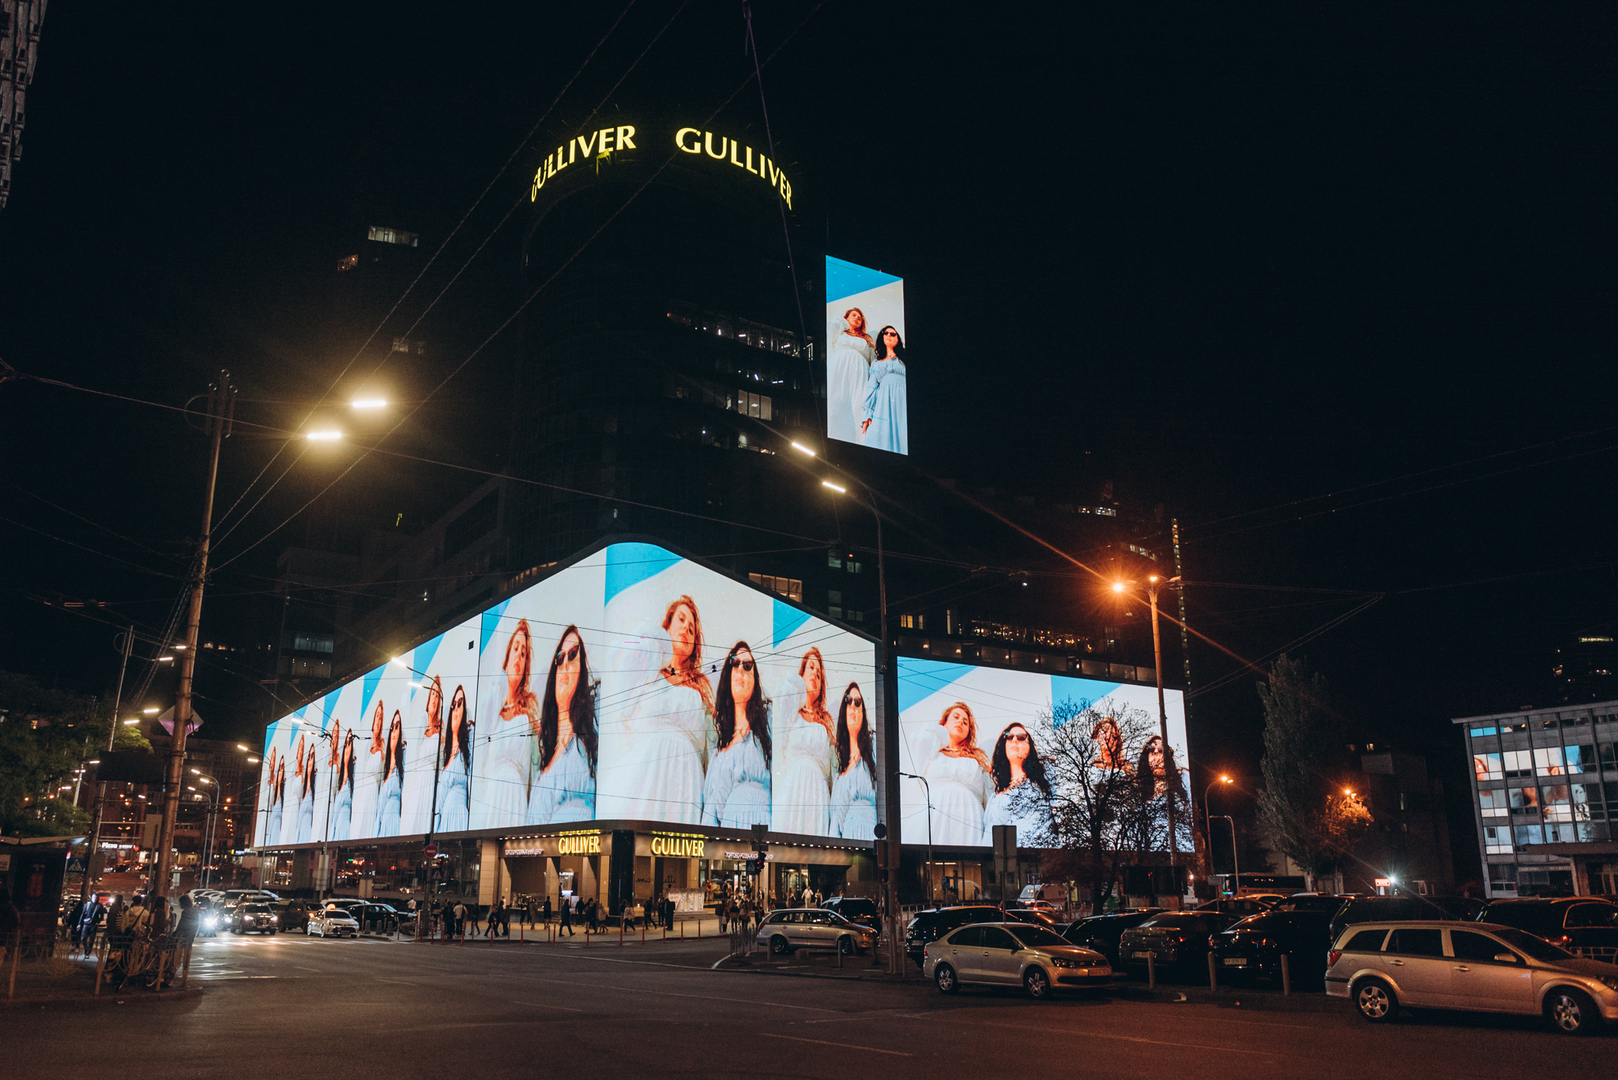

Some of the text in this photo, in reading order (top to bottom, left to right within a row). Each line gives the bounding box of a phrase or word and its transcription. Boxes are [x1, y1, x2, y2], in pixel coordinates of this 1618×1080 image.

[675, 127, 792, 210] GULLIVER
[558, 836, 601, 854] GULLIVER
[651, 837, 704, 857] GULLIVER
